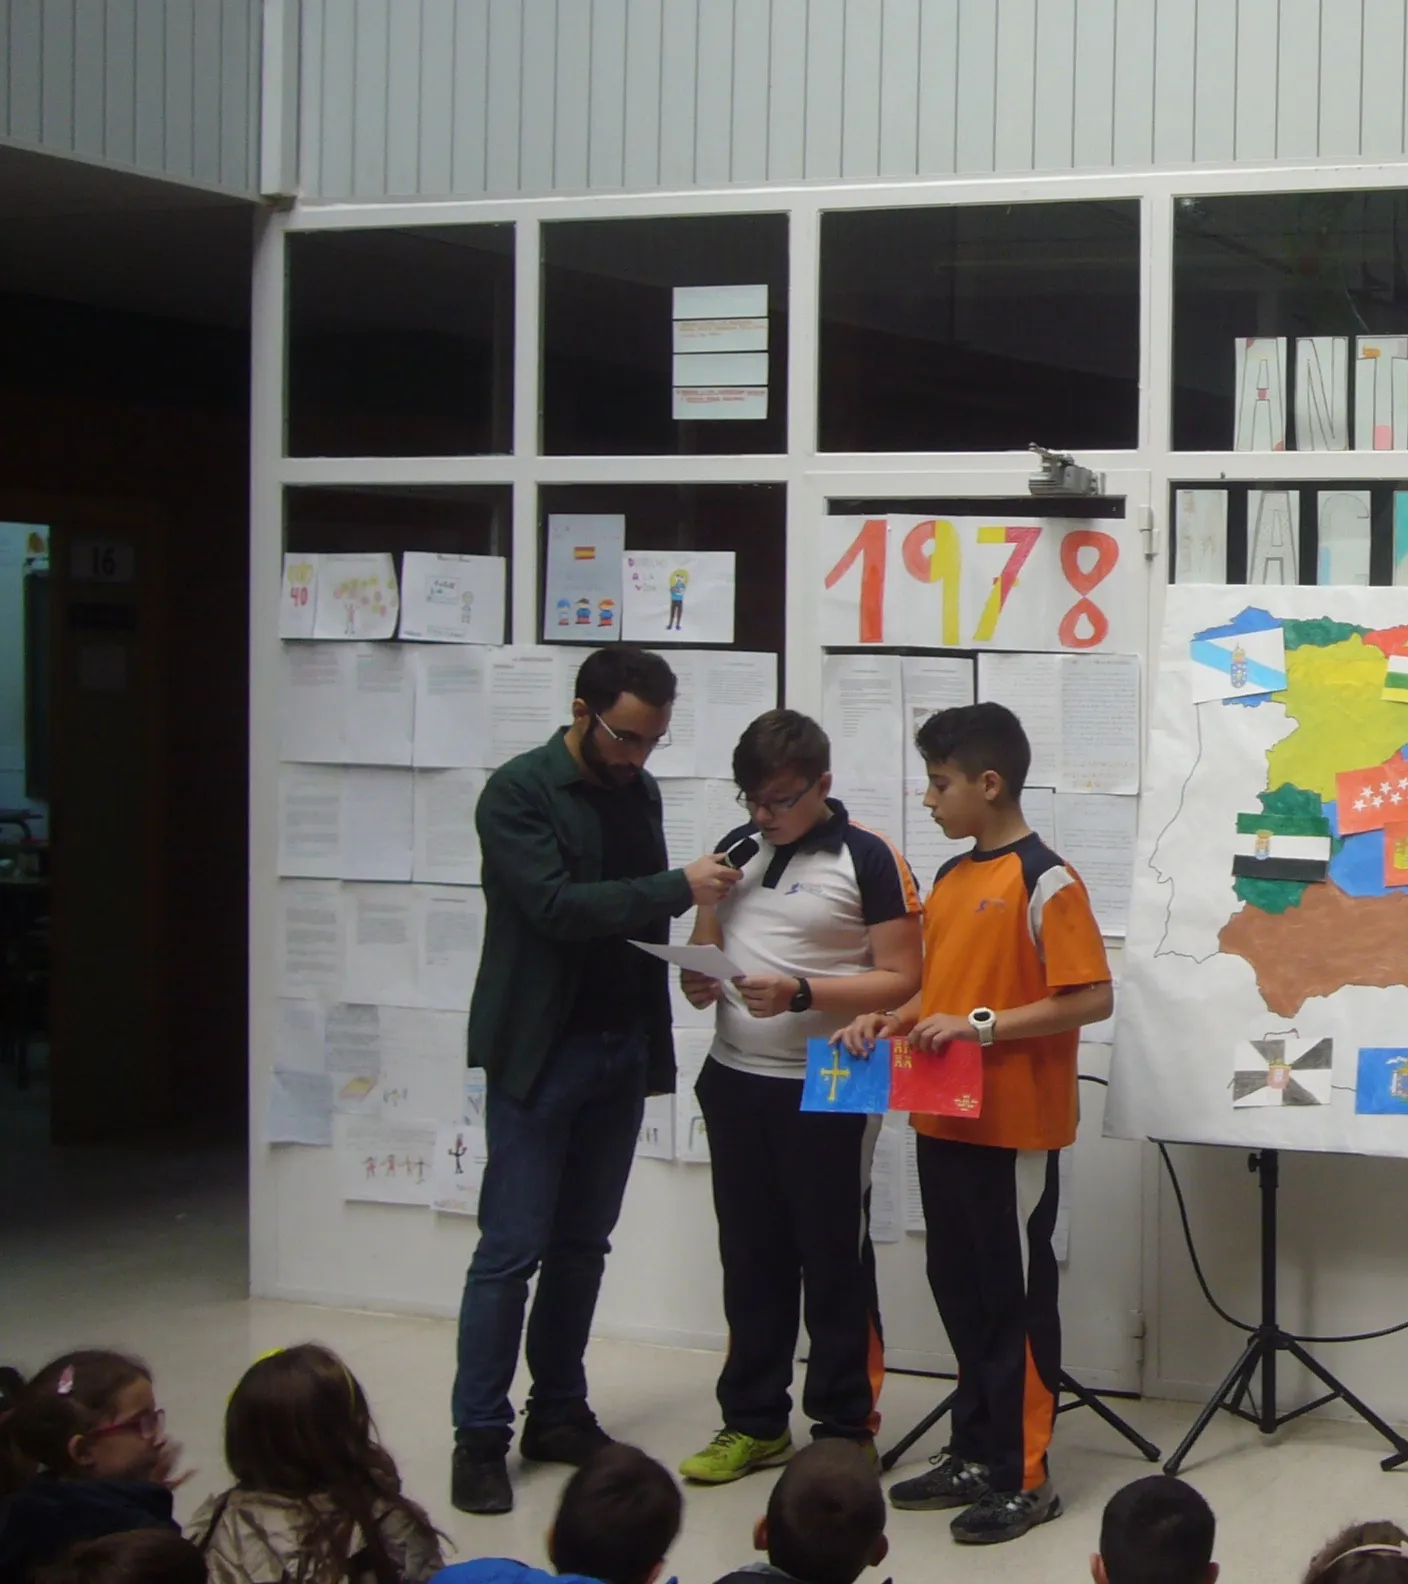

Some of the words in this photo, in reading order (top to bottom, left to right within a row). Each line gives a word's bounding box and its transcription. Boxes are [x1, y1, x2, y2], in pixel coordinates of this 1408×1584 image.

[91, 546, 117, 577] 16
[290, 585, 308, 607] 40
[823, 518, 1120, 649] 1978
